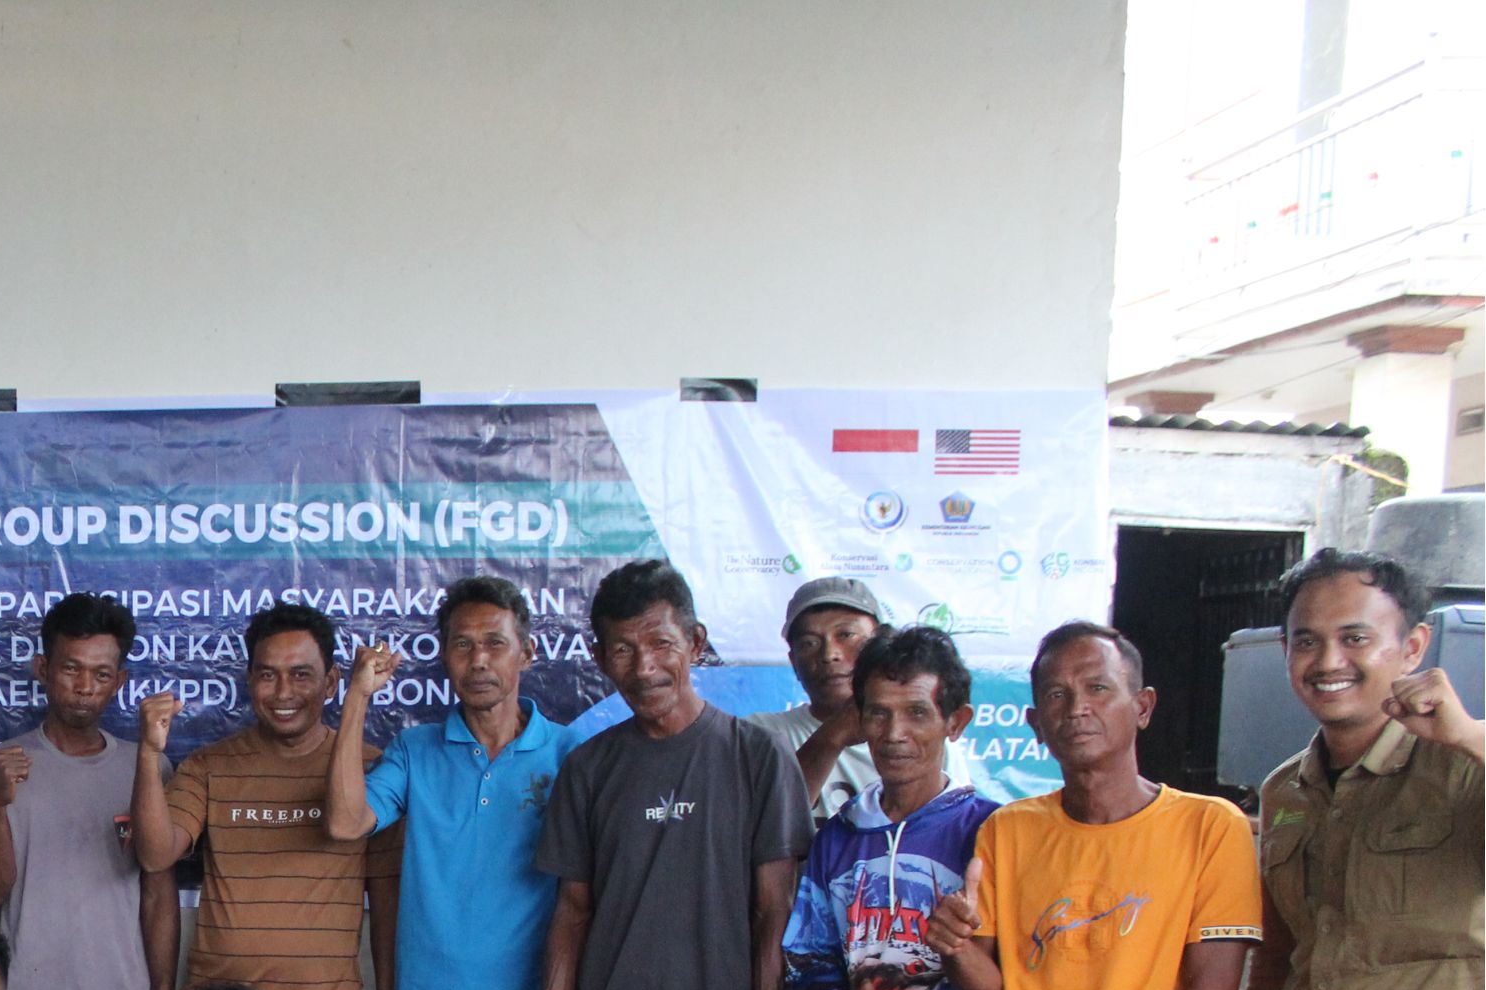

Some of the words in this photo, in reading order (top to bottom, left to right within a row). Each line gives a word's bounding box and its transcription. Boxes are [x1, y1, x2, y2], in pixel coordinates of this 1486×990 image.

[119, 501, 420, 545] DISCUSSION
[434, 499, 568, 548] (FGD)
[740, 553, 782, 566] Nature
